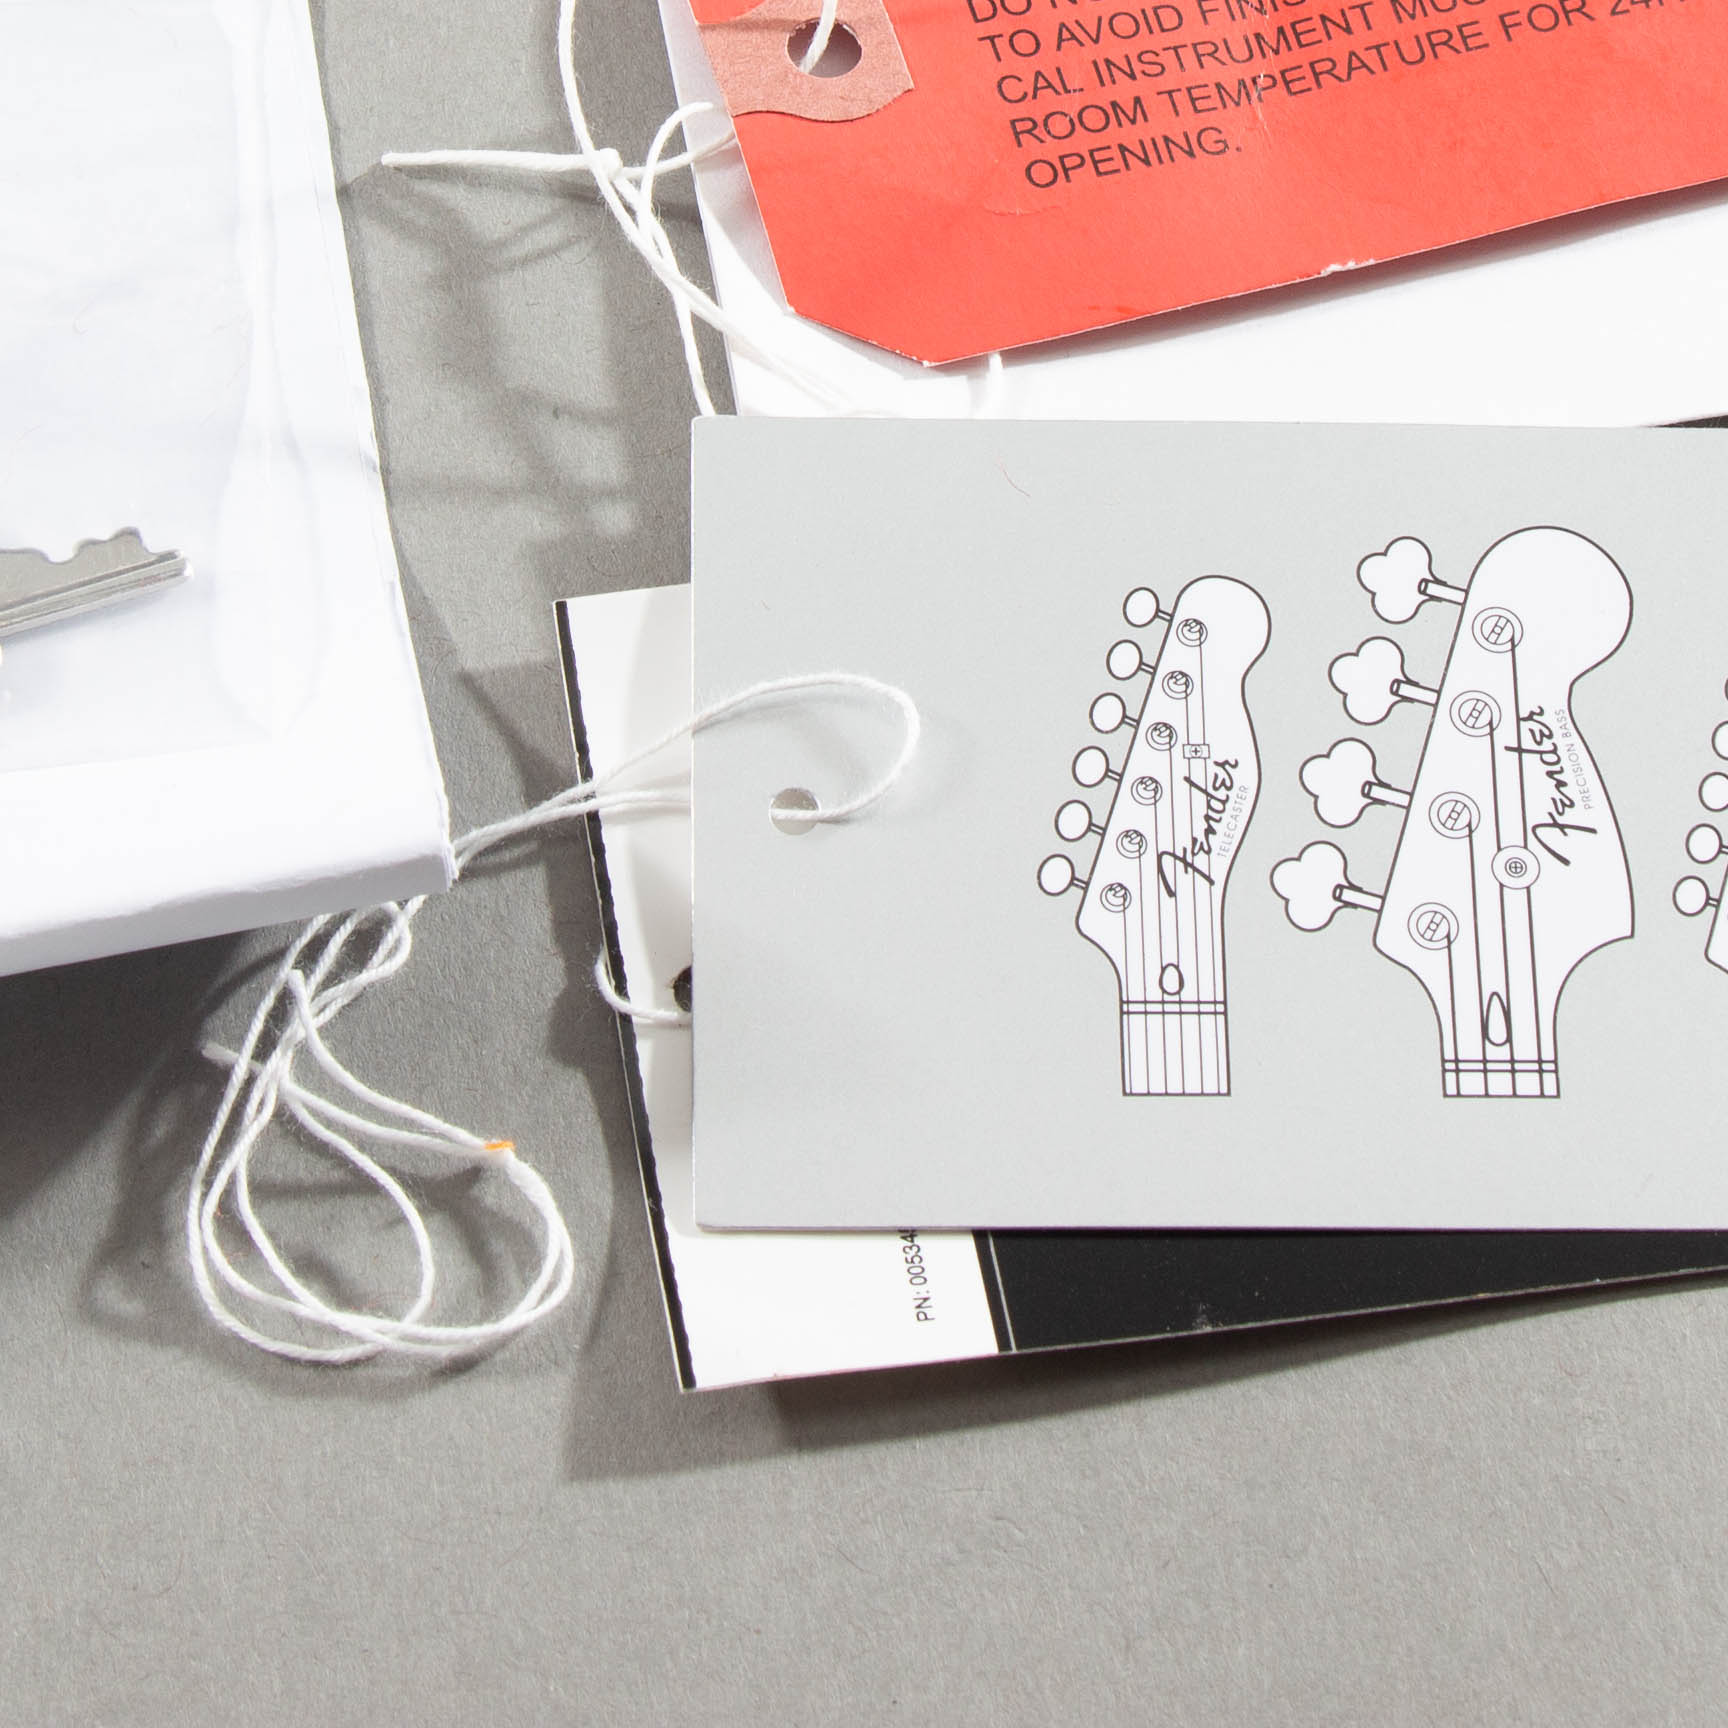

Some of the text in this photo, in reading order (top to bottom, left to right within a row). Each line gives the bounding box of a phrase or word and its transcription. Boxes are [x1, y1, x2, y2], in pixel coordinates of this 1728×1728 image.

[979, 29, 1040, 62] TO
[1056, 4, 1184, 52] AVOID
[997, 69, 1082, 104] CAL
[1097, 3, 1373, 88] INSTRUMENT
[1010, 95, 1148, 148] ROOM
[1158, 22, 1488, 120] TEMPERATURE
[1025, 127, 1242, 188] OPENING.
[1504, 705, 1597, 866] Fender
[1555, 708, 1594, 810] PRECISION BASS
[1158, 759, 1238, 897] Fender
[1217, 784, 1249, 858] TELECASTER
[899, 1227, 935, 1322] PN: 00534
